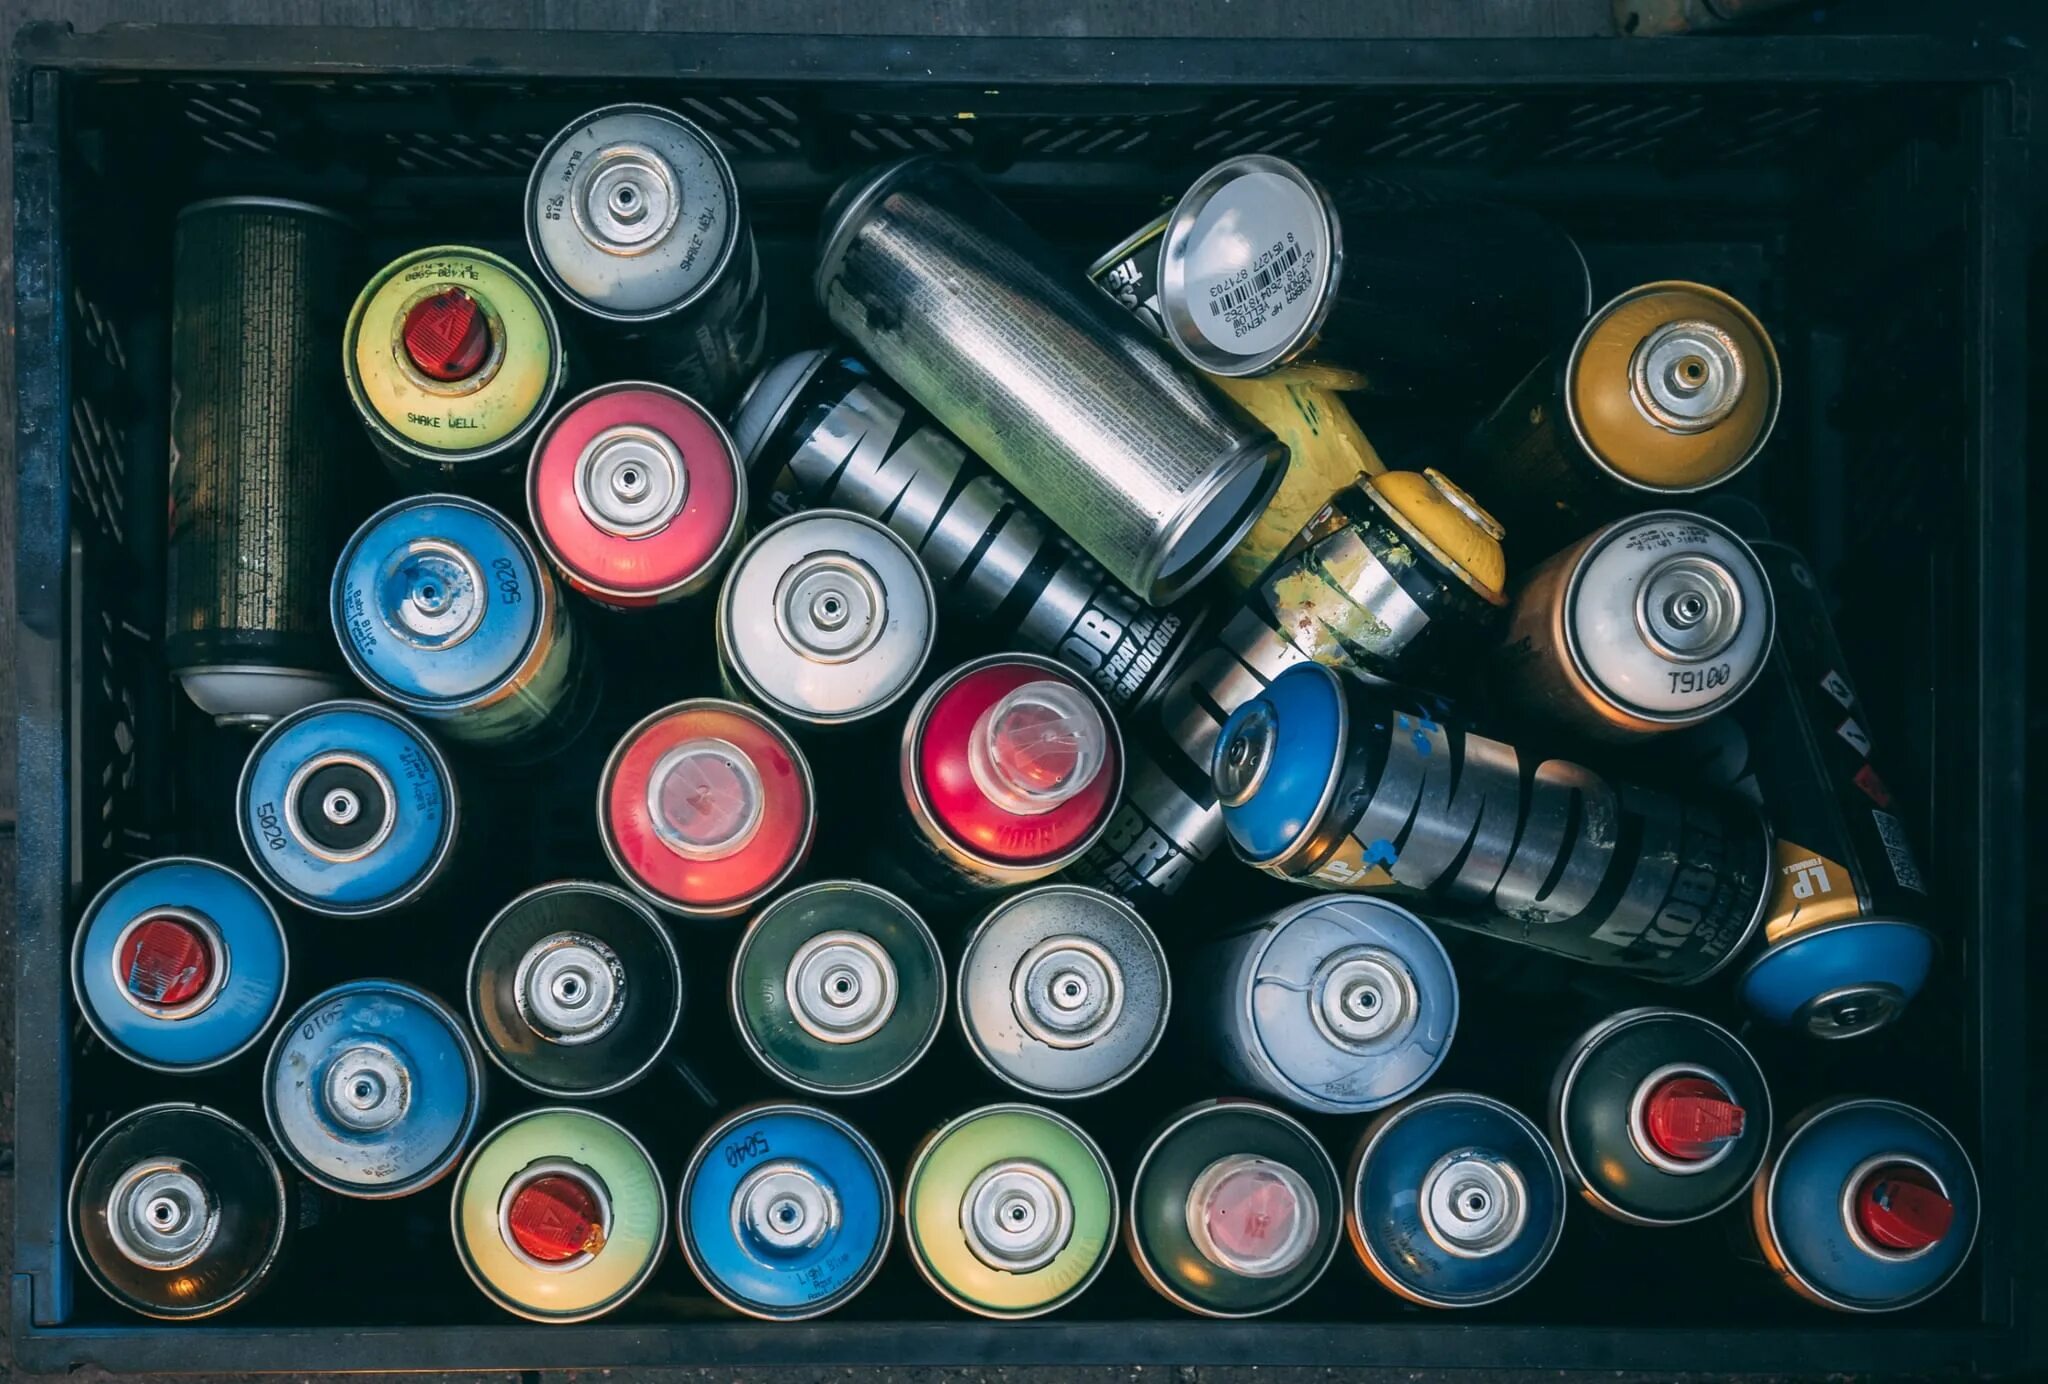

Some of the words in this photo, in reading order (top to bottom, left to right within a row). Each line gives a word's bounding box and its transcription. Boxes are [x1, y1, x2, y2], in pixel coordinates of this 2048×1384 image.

[679, 234, 703, 271] SHAKE
[698, 206, 715, 233] WELL
[1287, 232, 1294, 243] 8
[1253, 241, 1284, 273] 051277
[1109, 257, 1143, 290] TEC
[1210, 269, 1248, 297] 871703
[1284, 269, 1310, 295] VENOM
[1287, 278, 1312, 304] KOBRA
[1233, 299, 1270, 329] YELLOW
[1235, 315, 1267, 338] VEN03
[1271, 304, 1283, 317] HP
[408, 413, 441, 428] SHAKE
[448, 418, 479, 429] WELL
[492, 558, 521, 606] 5020
[353, 589, 365, 616] Baby
[361, 619, 377, 645] Blue
[1095, 636, 1138, 691] SPRAY
[1112, 613, 1181, 701] ECHNOLOGIES
[1668, 663, 1730, 694] T9100
[256, 802, 287, 851] 5020
[1793, 866, 1831, 899] LP
[725, 1130, 769, 1168] 5040
